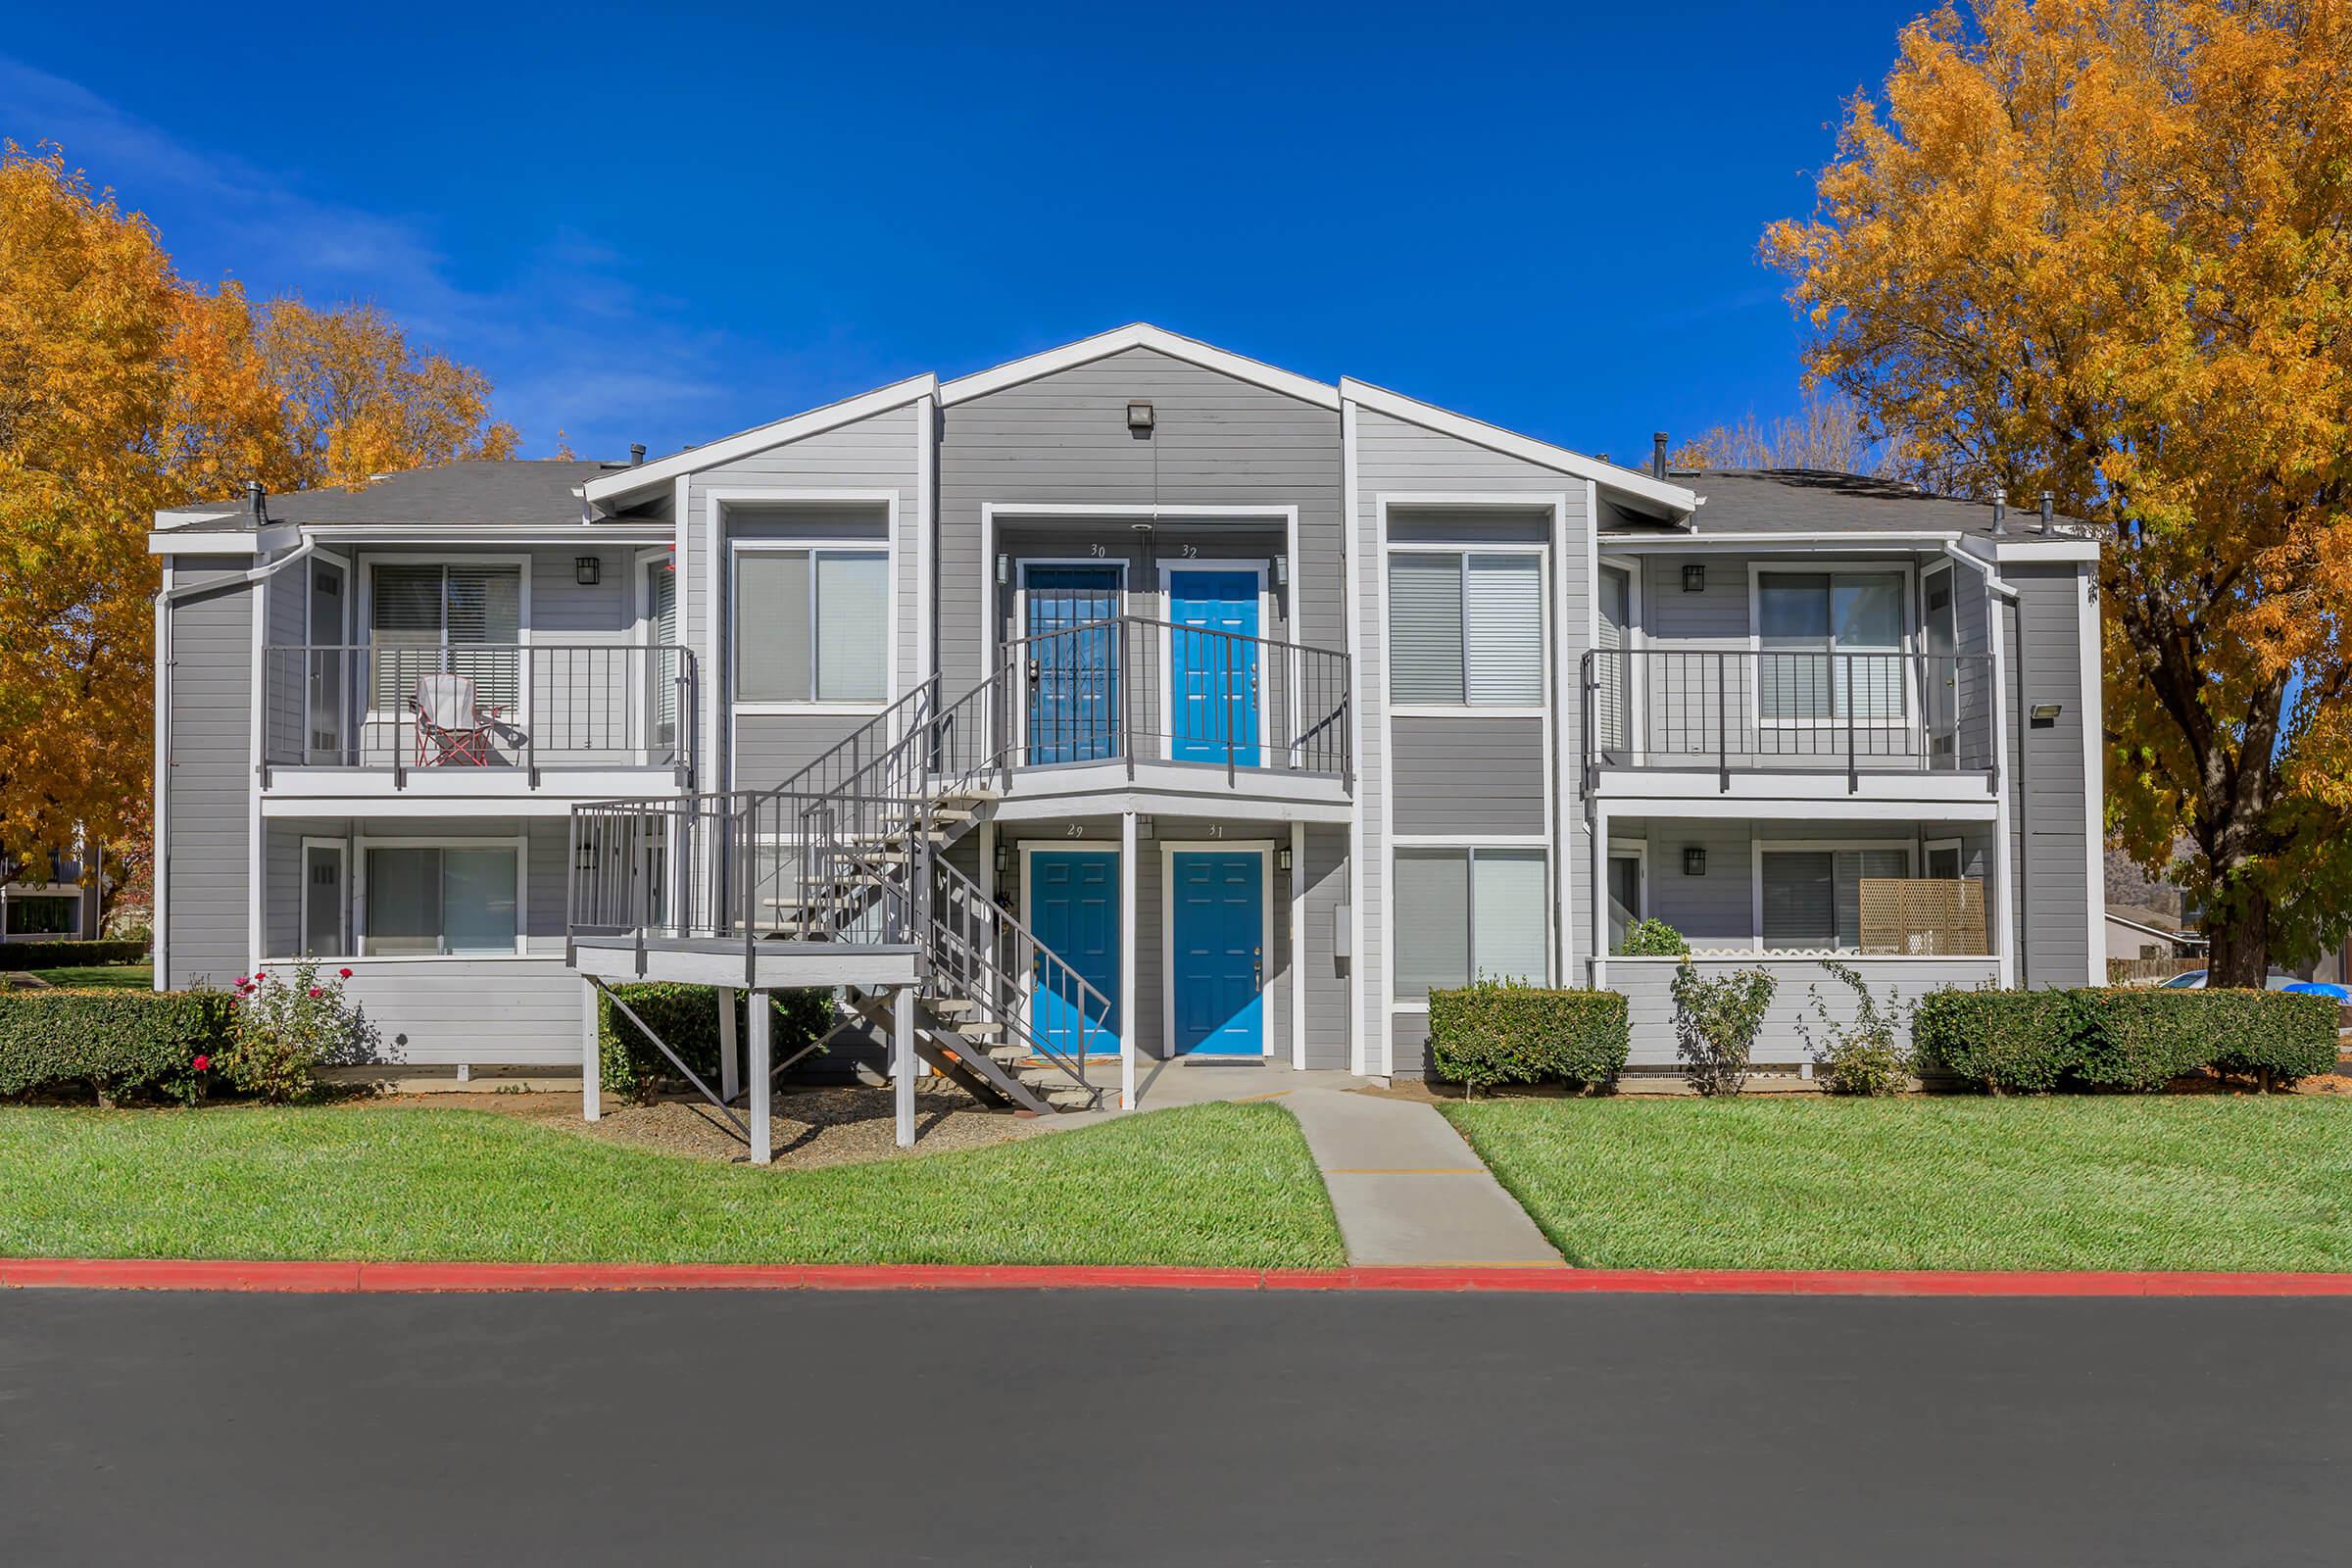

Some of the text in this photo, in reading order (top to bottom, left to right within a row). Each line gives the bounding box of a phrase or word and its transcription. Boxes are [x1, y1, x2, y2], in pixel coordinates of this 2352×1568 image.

[1091, 543, 1105, 558] 30
[1182, 544, 1197, 558] 32
[1067, 823, 1083, 838] 29
[1208, 823, 1222, 838] 31
